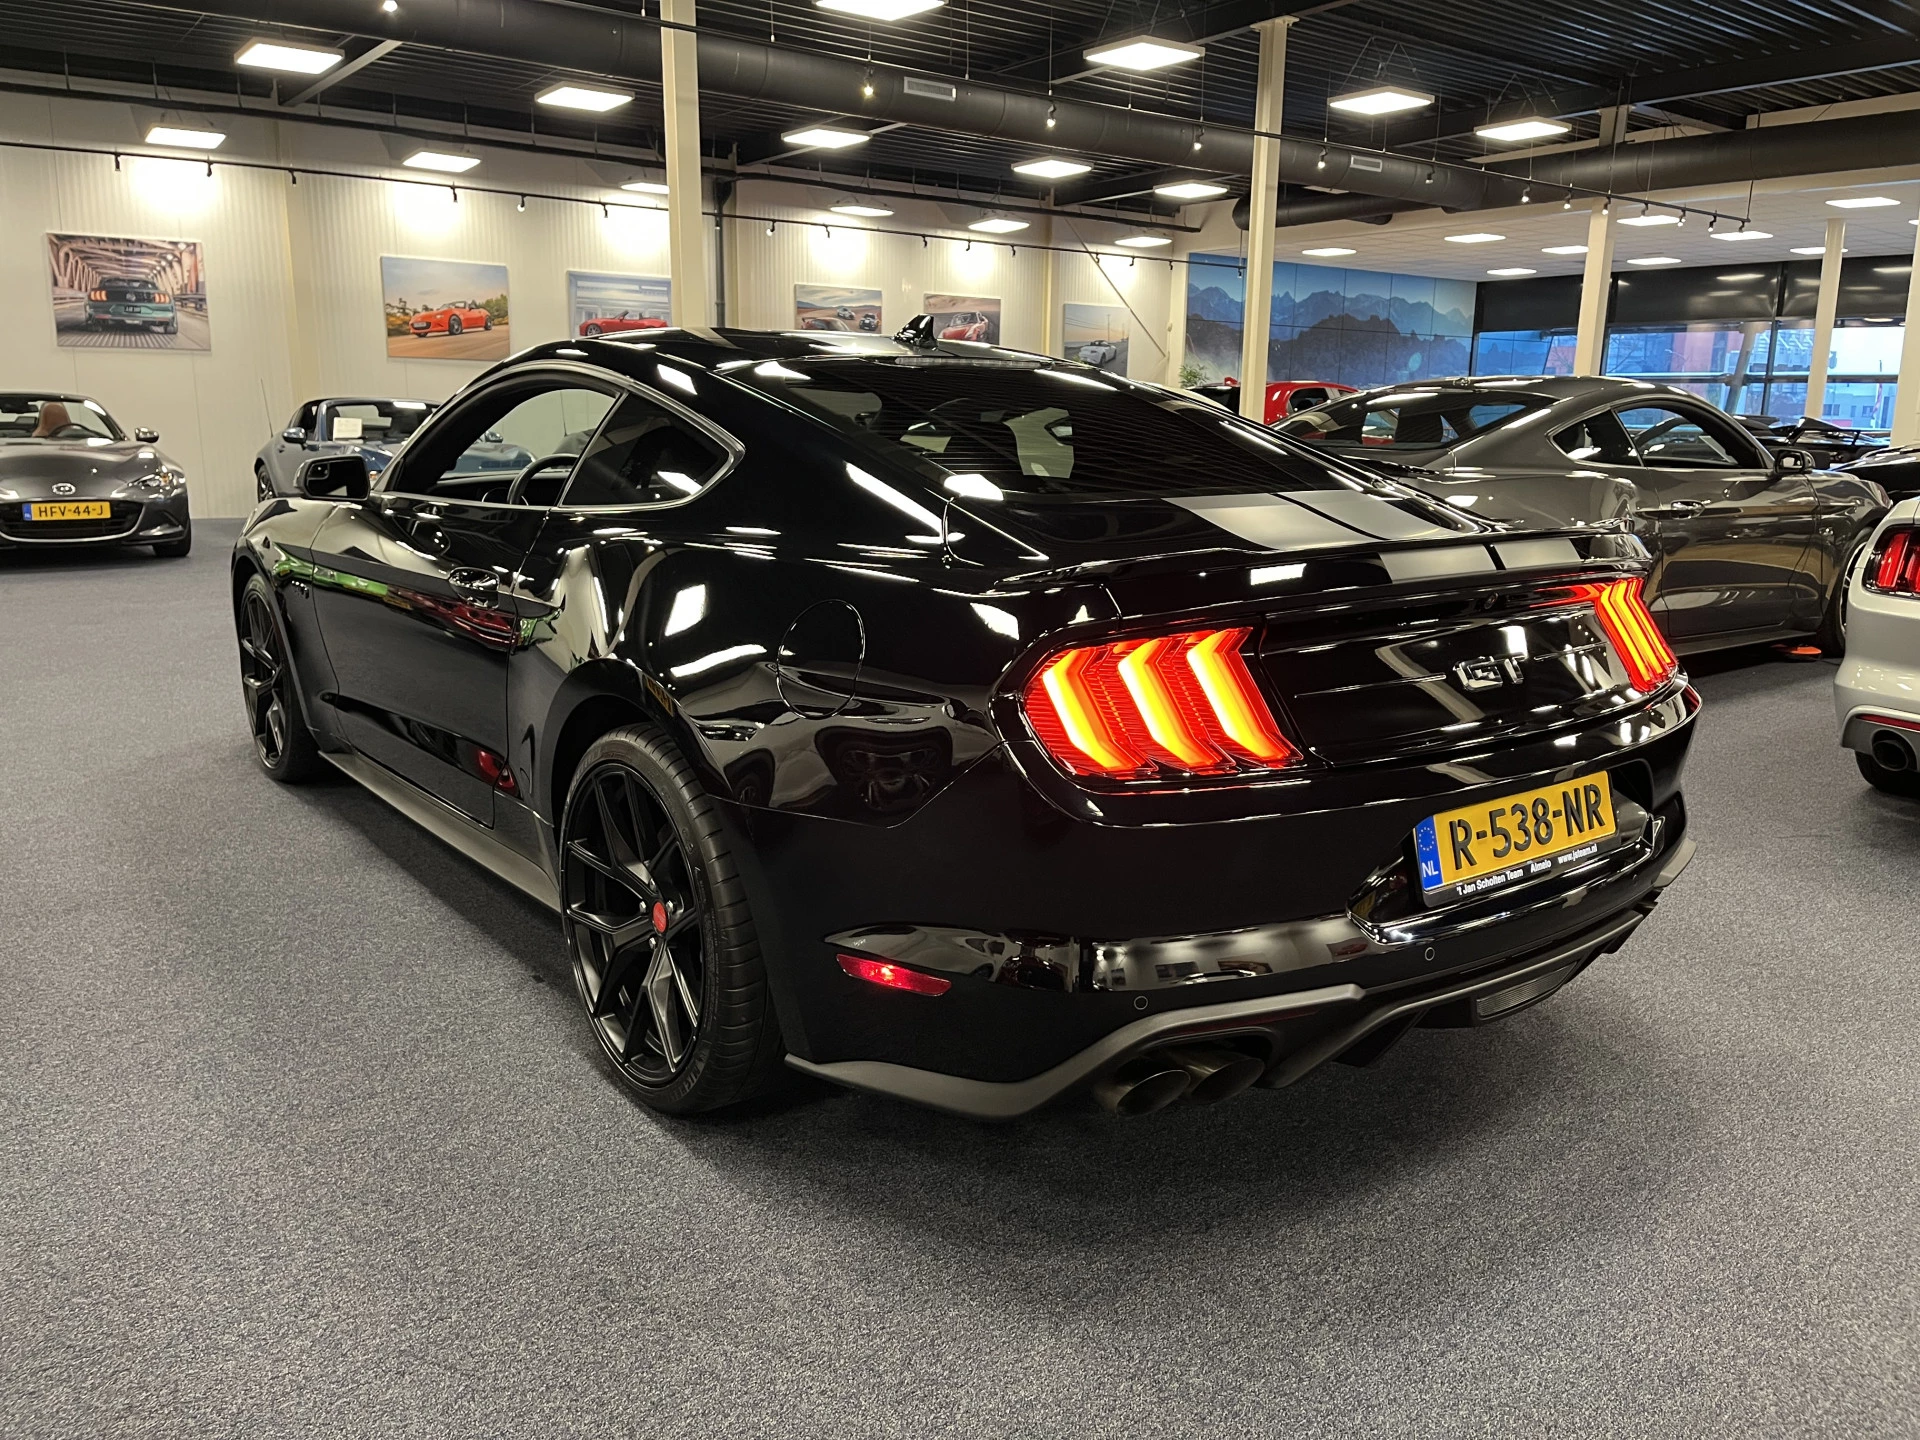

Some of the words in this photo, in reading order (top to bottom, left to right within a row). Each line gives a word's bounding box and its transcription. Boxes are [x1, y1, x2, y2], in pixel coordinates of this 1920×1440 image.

[38, 505, 104, 518] HFV-44-J
[1453, 655, 1527, 692] GT
[1449, 783, 1606, 871] R-538-NR
[1421, 861, 1439, 878] NL
[1463, 884, 1476, 894] Jan
[1476, 876, 1506, 889] Scholten
[1506, 868, 1524, 880] Team
[1530, 859, 1552, 873] Almelo
